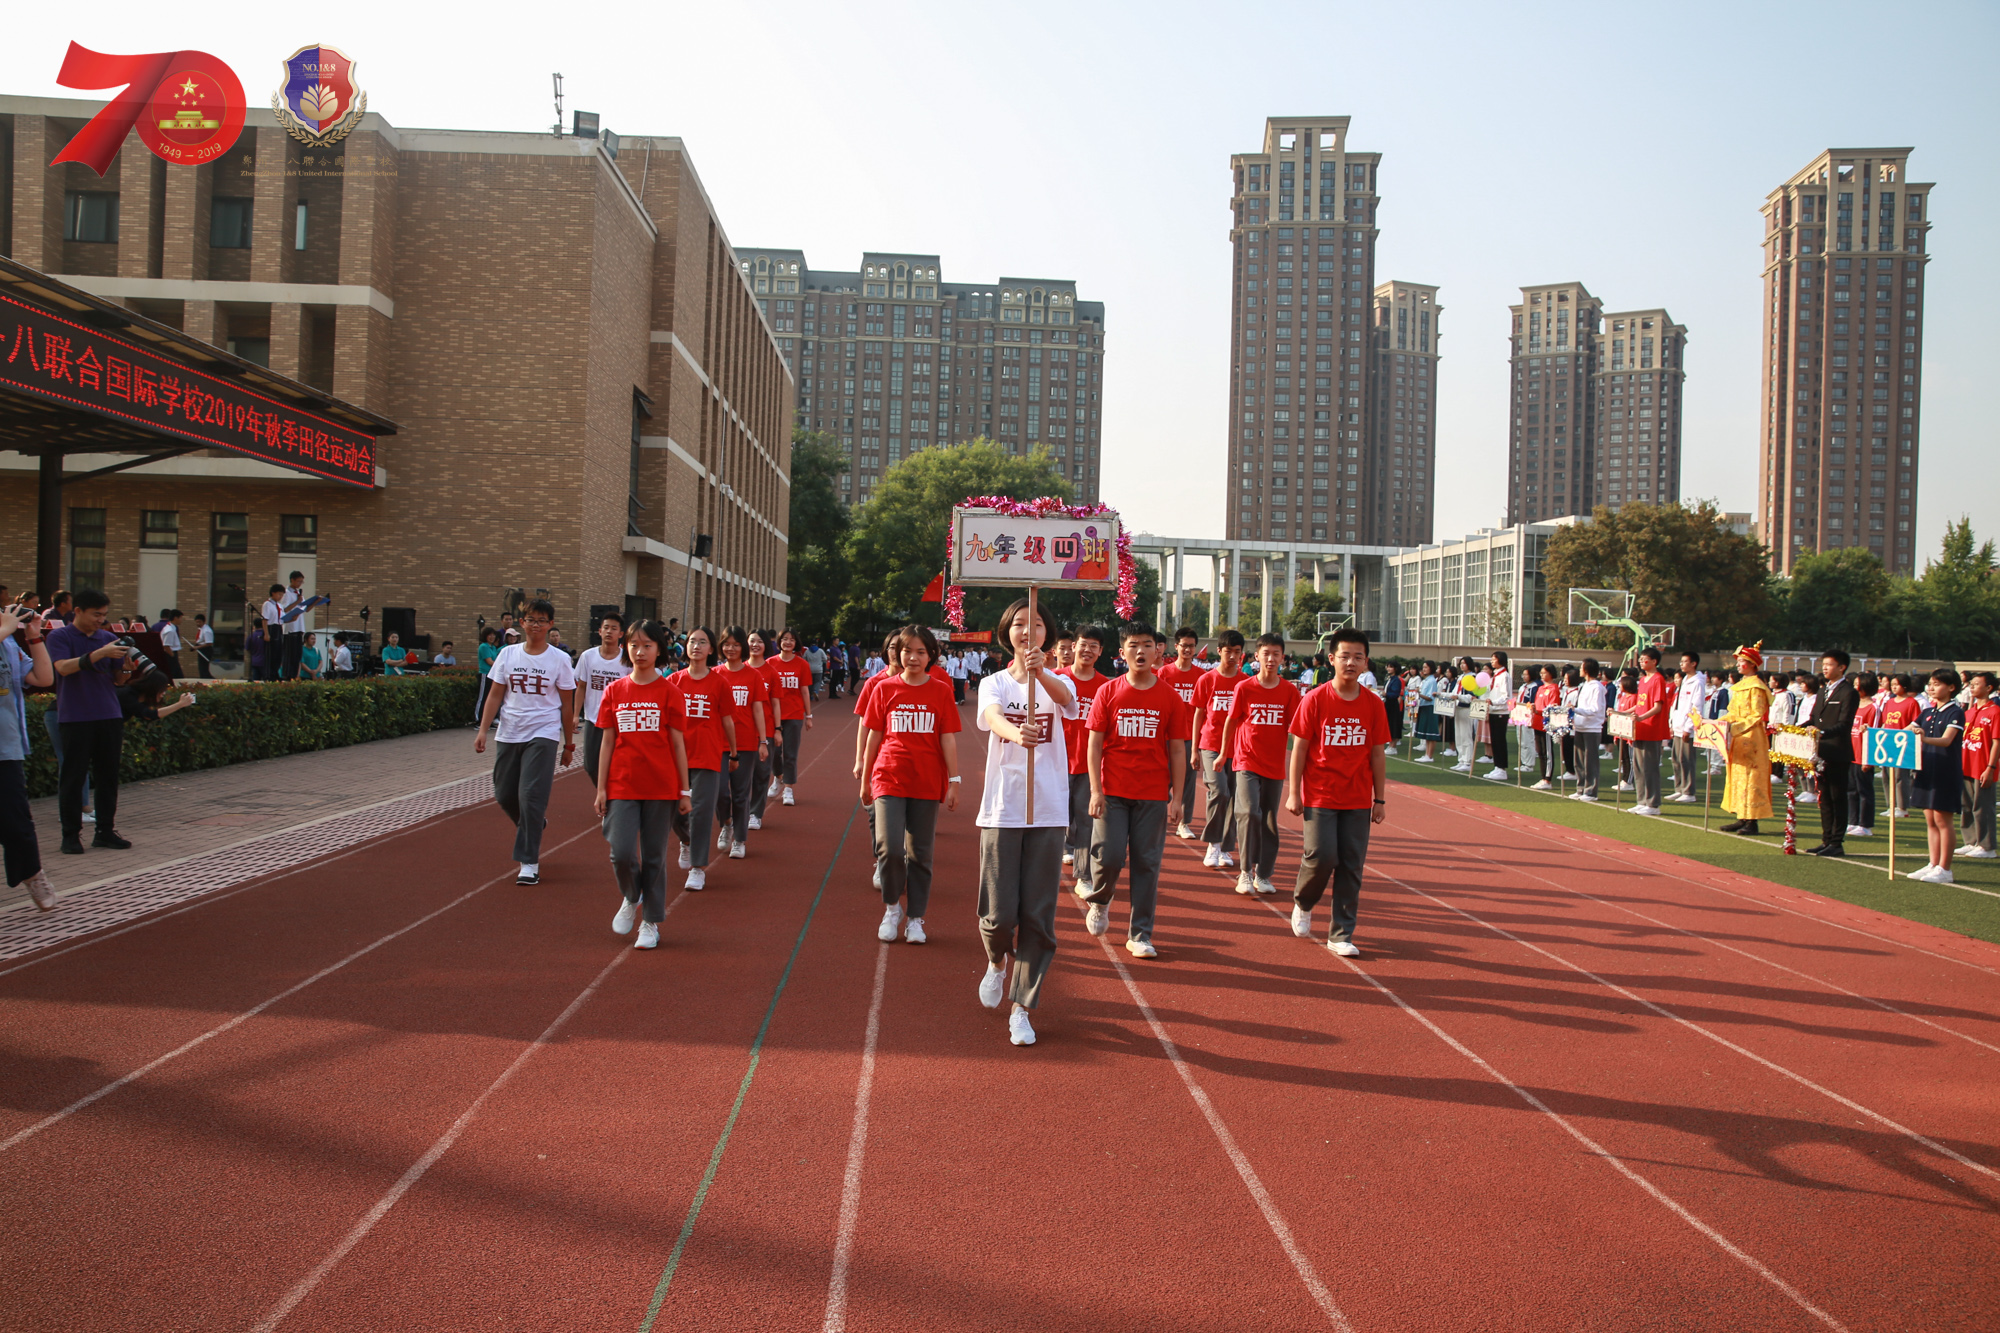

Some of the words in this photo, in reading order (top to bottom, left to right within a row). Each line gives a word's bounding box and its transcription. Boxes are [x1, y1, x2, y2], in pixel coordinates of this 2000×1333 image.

[0, 324, 372, 475] 八联合国际学校2019年秋季田径运动会
[965, 533, 1107, 565] 九年级四班
[531, 667, 546, 675] ZHU
[509, 674, 550, 696] 民主
[1007, 701, 1020, 710] AI
[615, 709, 661, 733] 富强
[890, 710, 935, 734] 敬业
[1116, 715, 1160, 738] 诚信
[1251, 709, 1284, 726] 公正
[1324, 725, 1367, 746] 法治
[1873, 729, 1908, 767] 8.9
